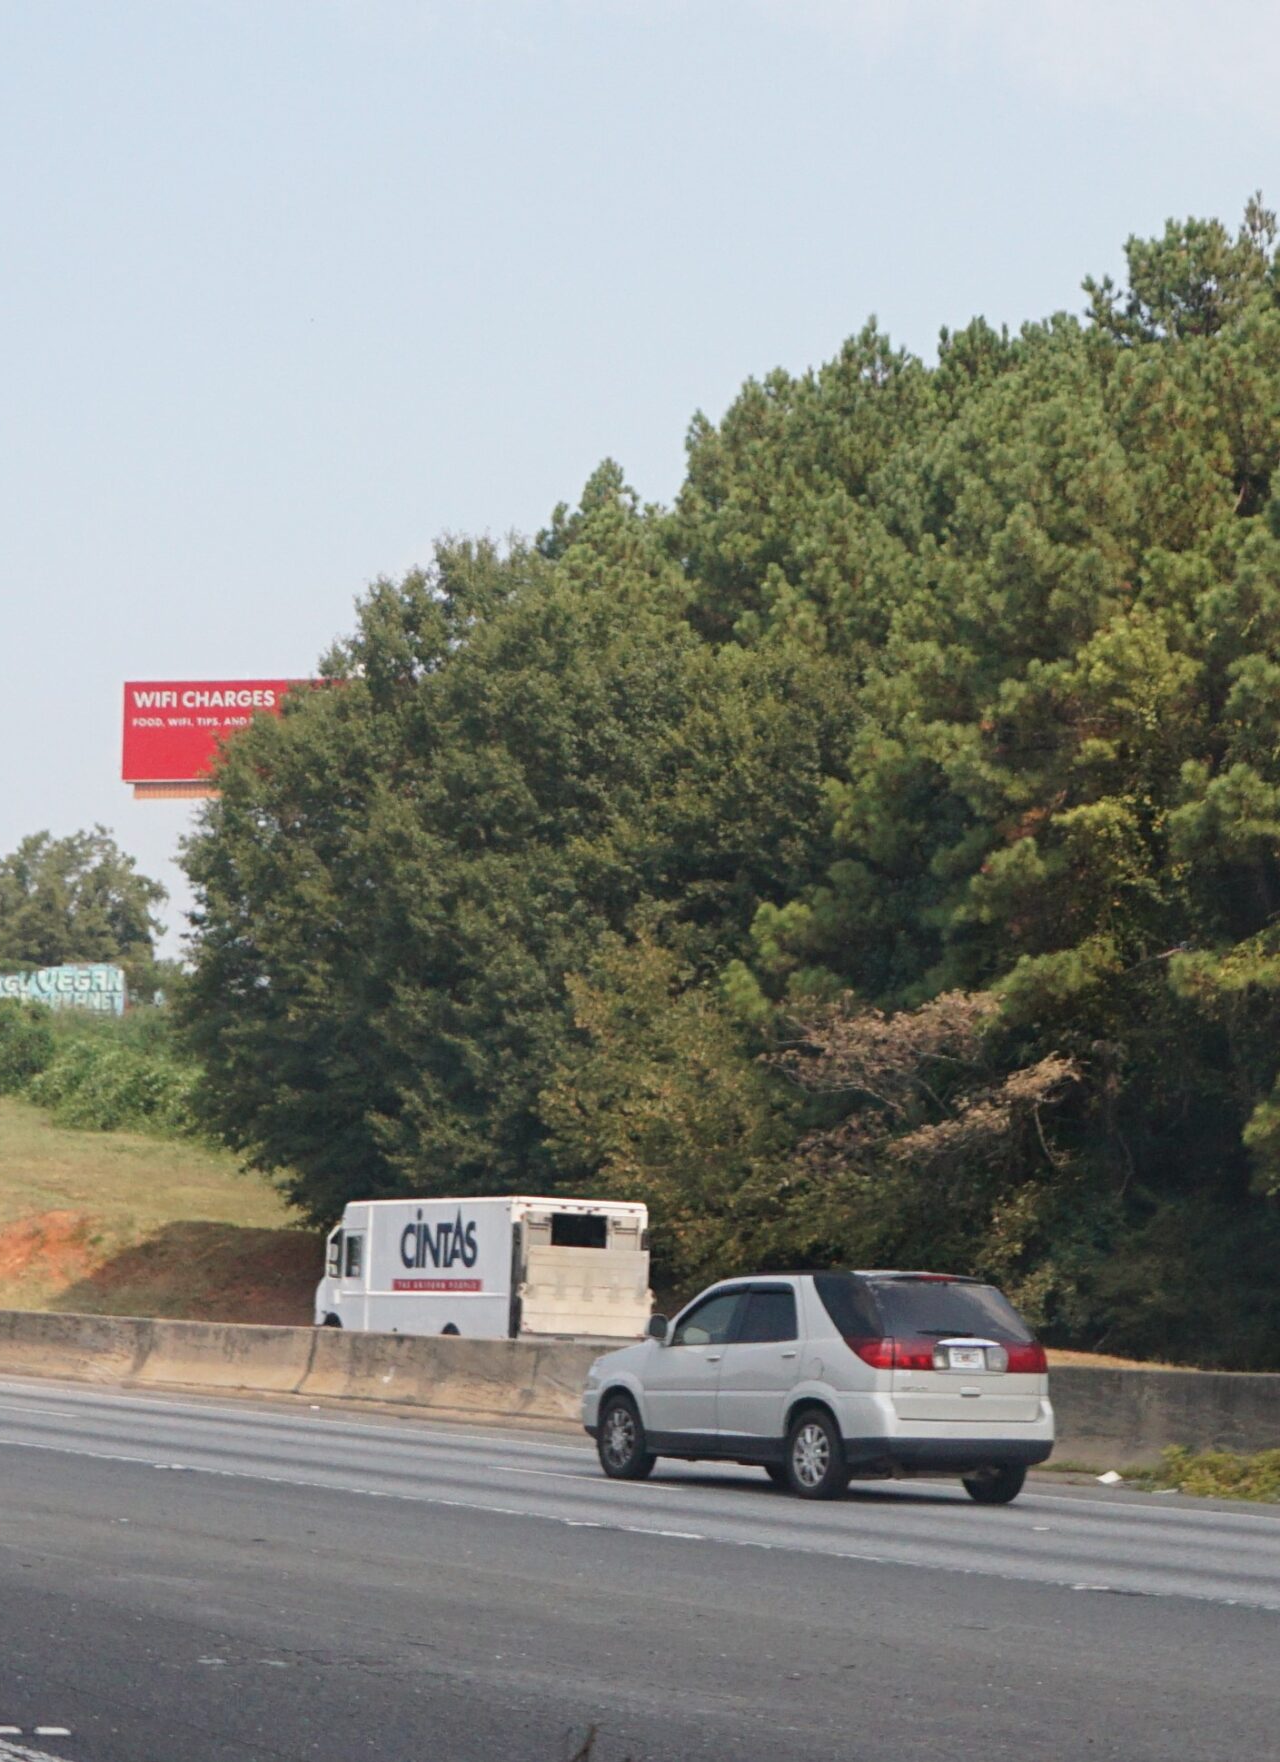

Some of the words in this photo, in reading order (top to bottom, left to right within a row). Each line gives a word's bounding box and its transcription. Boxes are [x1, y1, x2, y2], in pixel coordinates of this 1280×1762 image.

[133, 691, 178, 708] WIFI
[182, 690, 276, 708] CHARGES
[223, 715, 248, 726] AND
[36, 969, 125, 993] VEGAN
[400, 1206, 478, 1269] CINTAS
